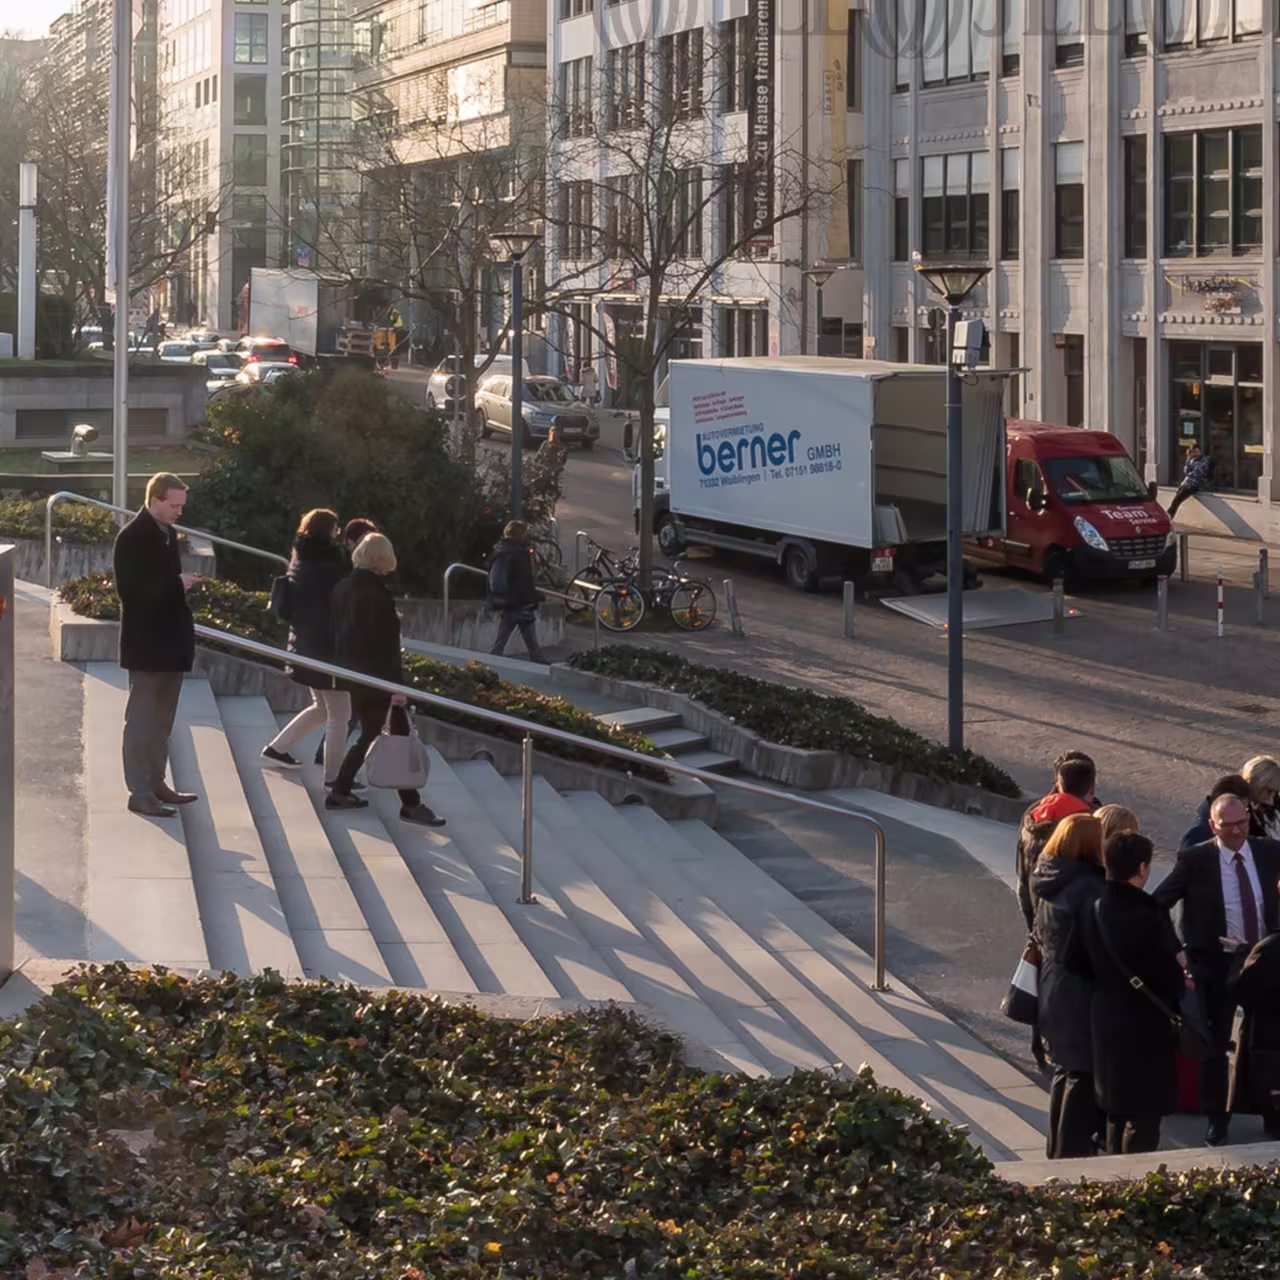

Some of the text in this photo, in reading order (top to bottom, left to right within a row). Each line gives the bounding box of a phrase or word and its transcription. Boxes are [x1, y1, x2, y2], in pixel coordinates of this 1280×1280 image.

[755, 0, 768, 81] trainieren
[755, 84, 768, 135] Hause
[703, 423, 764, 440] AUTOVERMIETUNG
[696, 429, 841, 476] berner GMBH
[721, 473, 760, 487] Waiblingen
[770, 469, 784, 480] Tel.
[785, 465, 807, 478] 07151
[1100, 510, 1148, 520] Team
